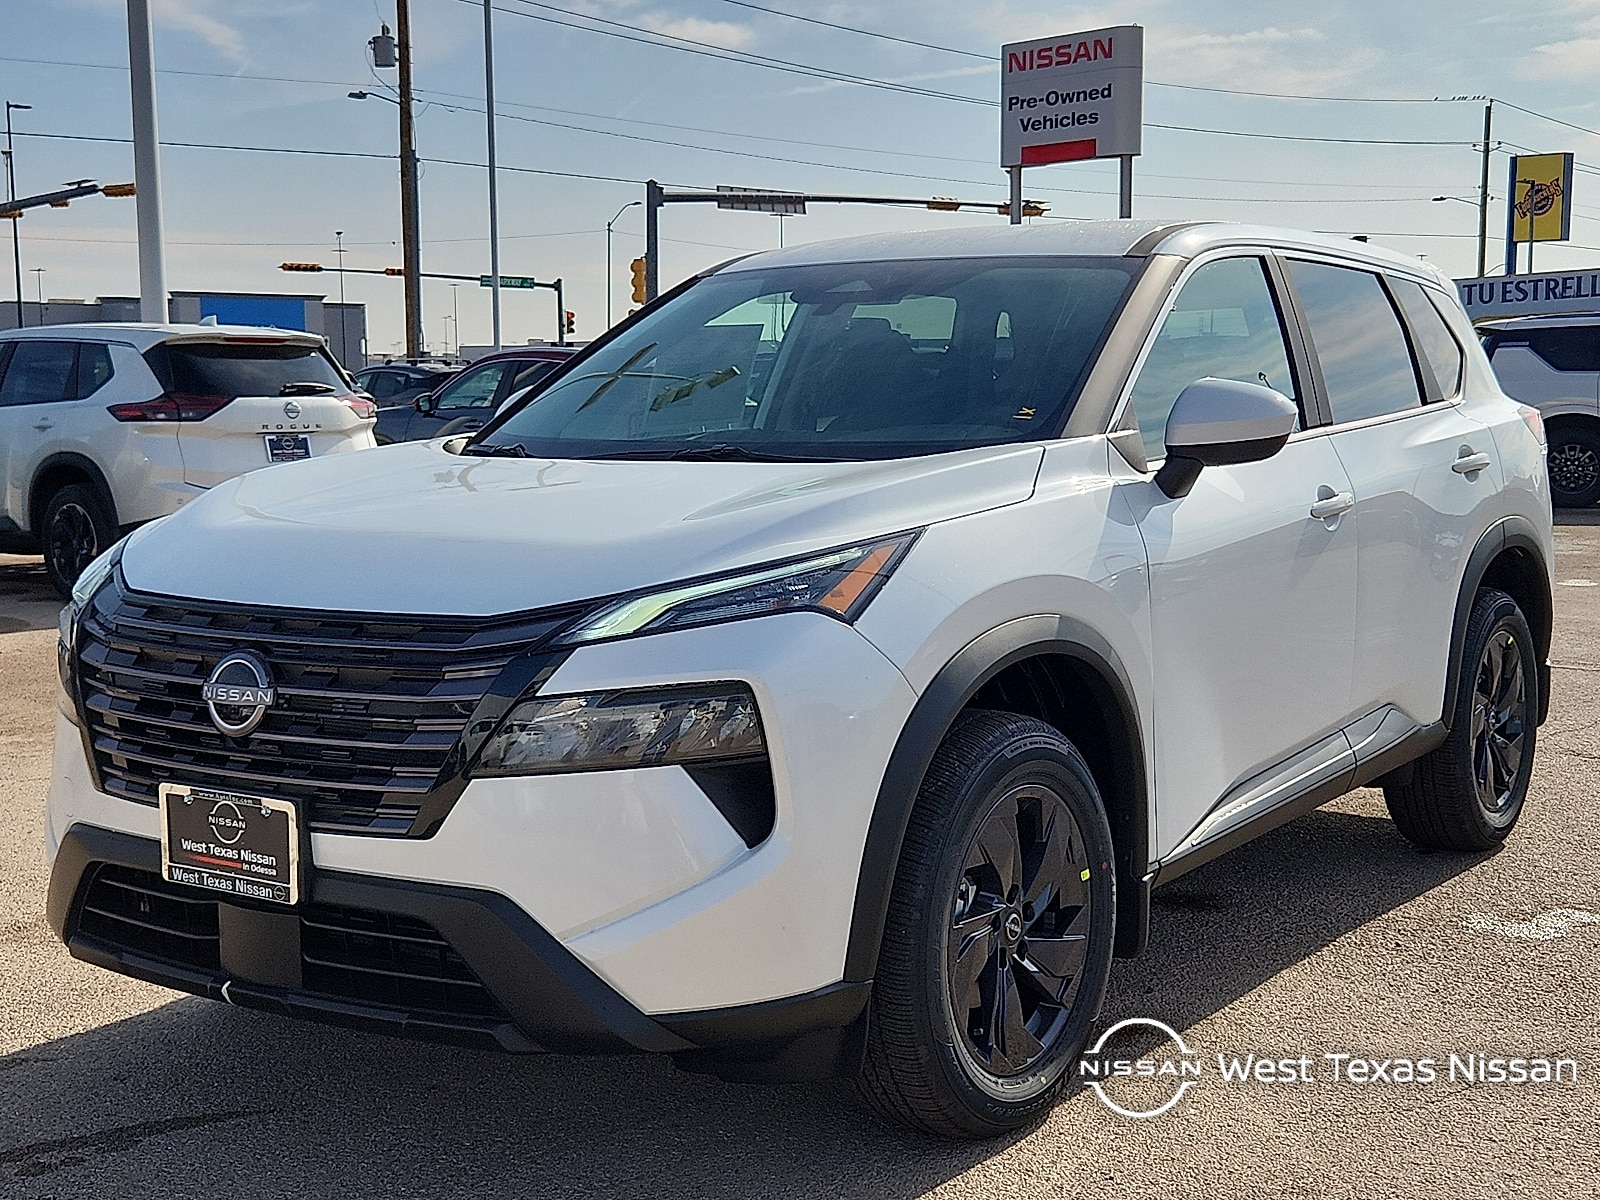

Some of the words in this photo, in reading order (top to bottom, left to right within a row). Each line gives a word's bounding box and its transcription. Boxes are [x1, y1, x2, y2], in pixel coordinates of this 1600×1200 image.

[1008, 37, 1113, 73] NISSAN
[1008, 82, 1112, 111] Pre-Owned
[1019, 111, 1099, 132] Vehicles
[1462, 282, 1495, 305] TU
[203, 685, 271, 702] NISSAN
[208, 815, 246, 829] NISSAN
[181, 838, 207, 854] West
[208, 843, 239, 859] Texas
[240, 849, 277, 867] Nissan
[250, 864, 277, 876] Odessa
[172, 867, 200, 884] West
[202, 872, 233, 890] Texas
[235, 879, 273, 898] Nissan
